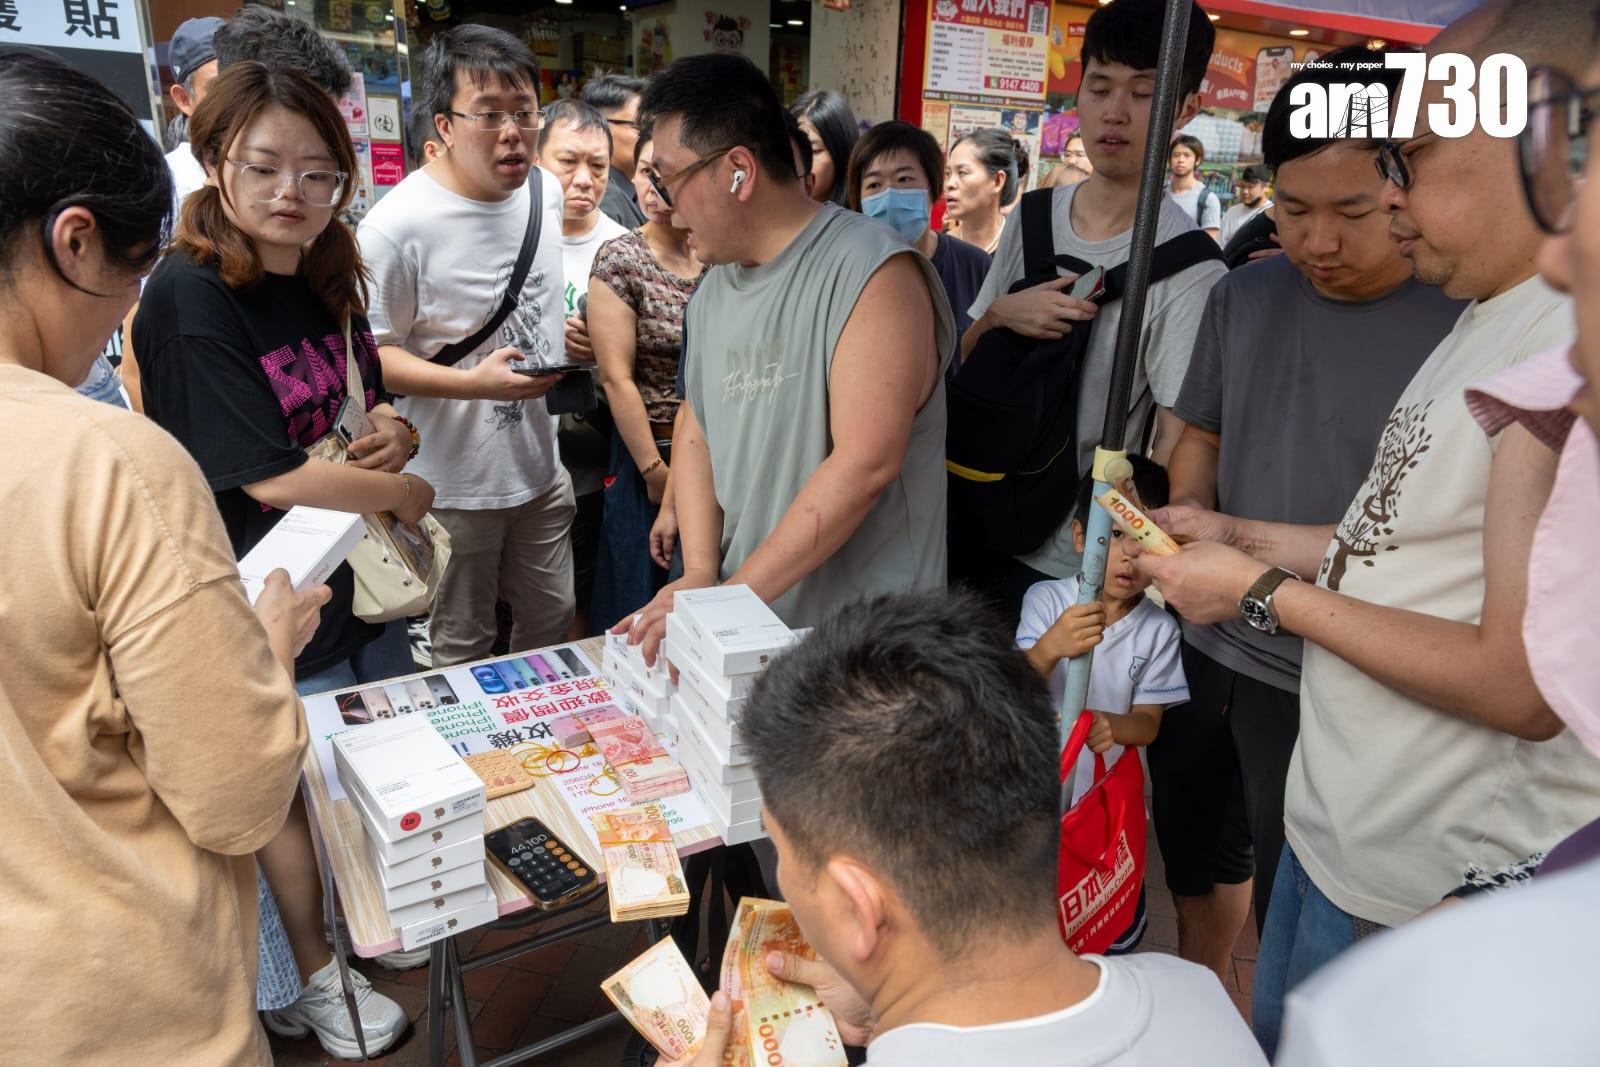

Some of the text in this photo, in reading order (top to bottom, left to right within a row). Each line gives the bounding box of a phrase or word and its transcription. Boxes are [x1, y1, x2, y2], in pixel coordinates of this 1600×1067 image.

[999, 78, 1041, 92] 9147 4400
[1109, 496, 1145, 530] 1000
[492, 677, 599, 709] 現金交收
[426, 700, 482, 718] iPhone
[431, 708, 487, 725] iPhone
[500, 690, 613, 725] 歡迎問價
[435, 715, 492, 732] iPhone
[580, 801, 616, 816] iPhone
[511, 834, 548, 855] 44,100
[676, 1018, 696, 1045] 1000
[758, 1023, 783, 1067] 000
